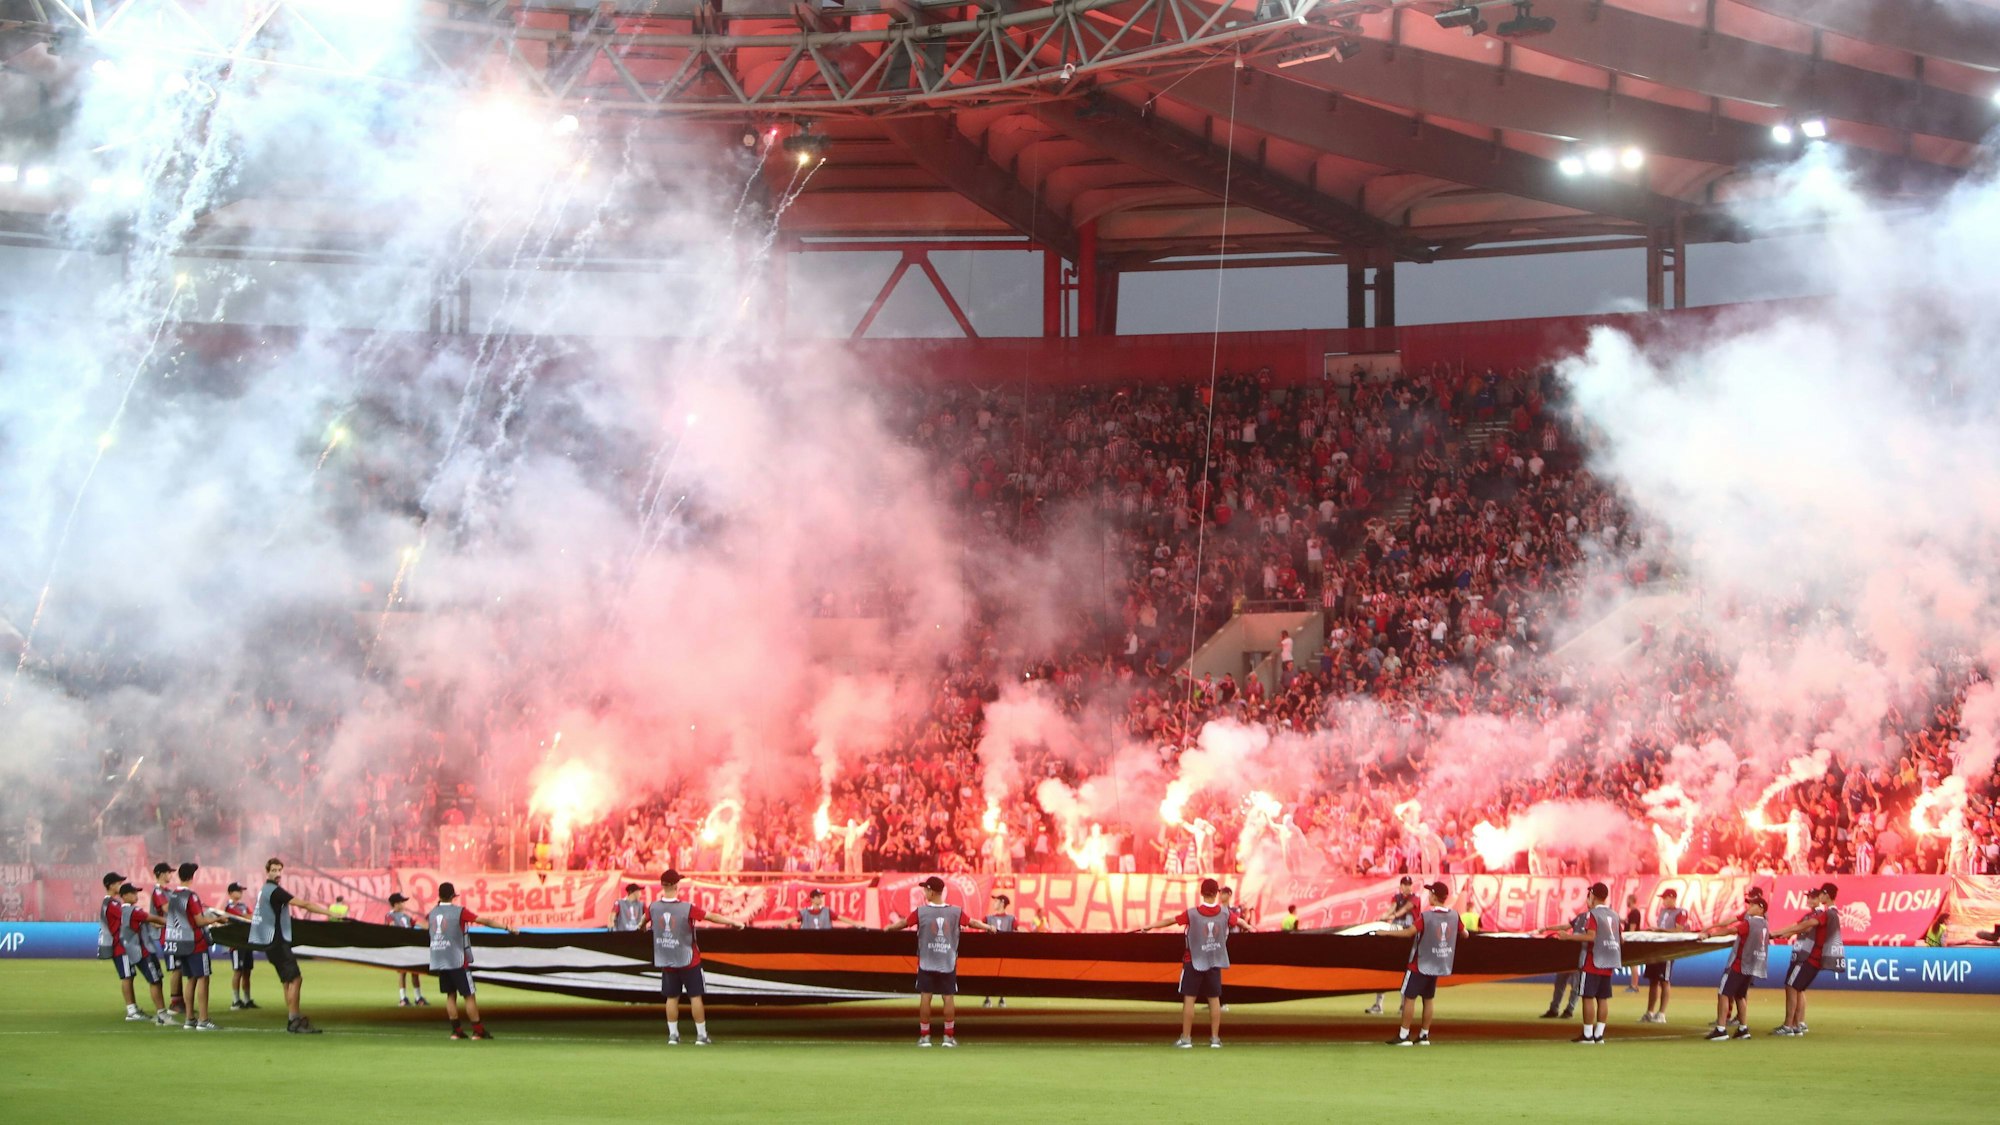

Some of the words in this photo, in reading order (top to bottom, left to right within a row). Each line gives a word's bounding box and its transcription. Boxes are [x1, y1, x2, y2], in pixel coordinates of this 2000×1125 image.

[409, 871, 575, 916] Pristeri
[775, 882, 866, 917] Lene
[1014, 873, 1244, 932] BRAHAI
[1469, 876, 1753, 930] PETRLONA
[1876, 888, 1942, 914] LIOSIA
[656, 937, 680, 946] EUROPA
[1835, 958, 1847, 968] 18
[1921, 960, 1972, 982] МИР
